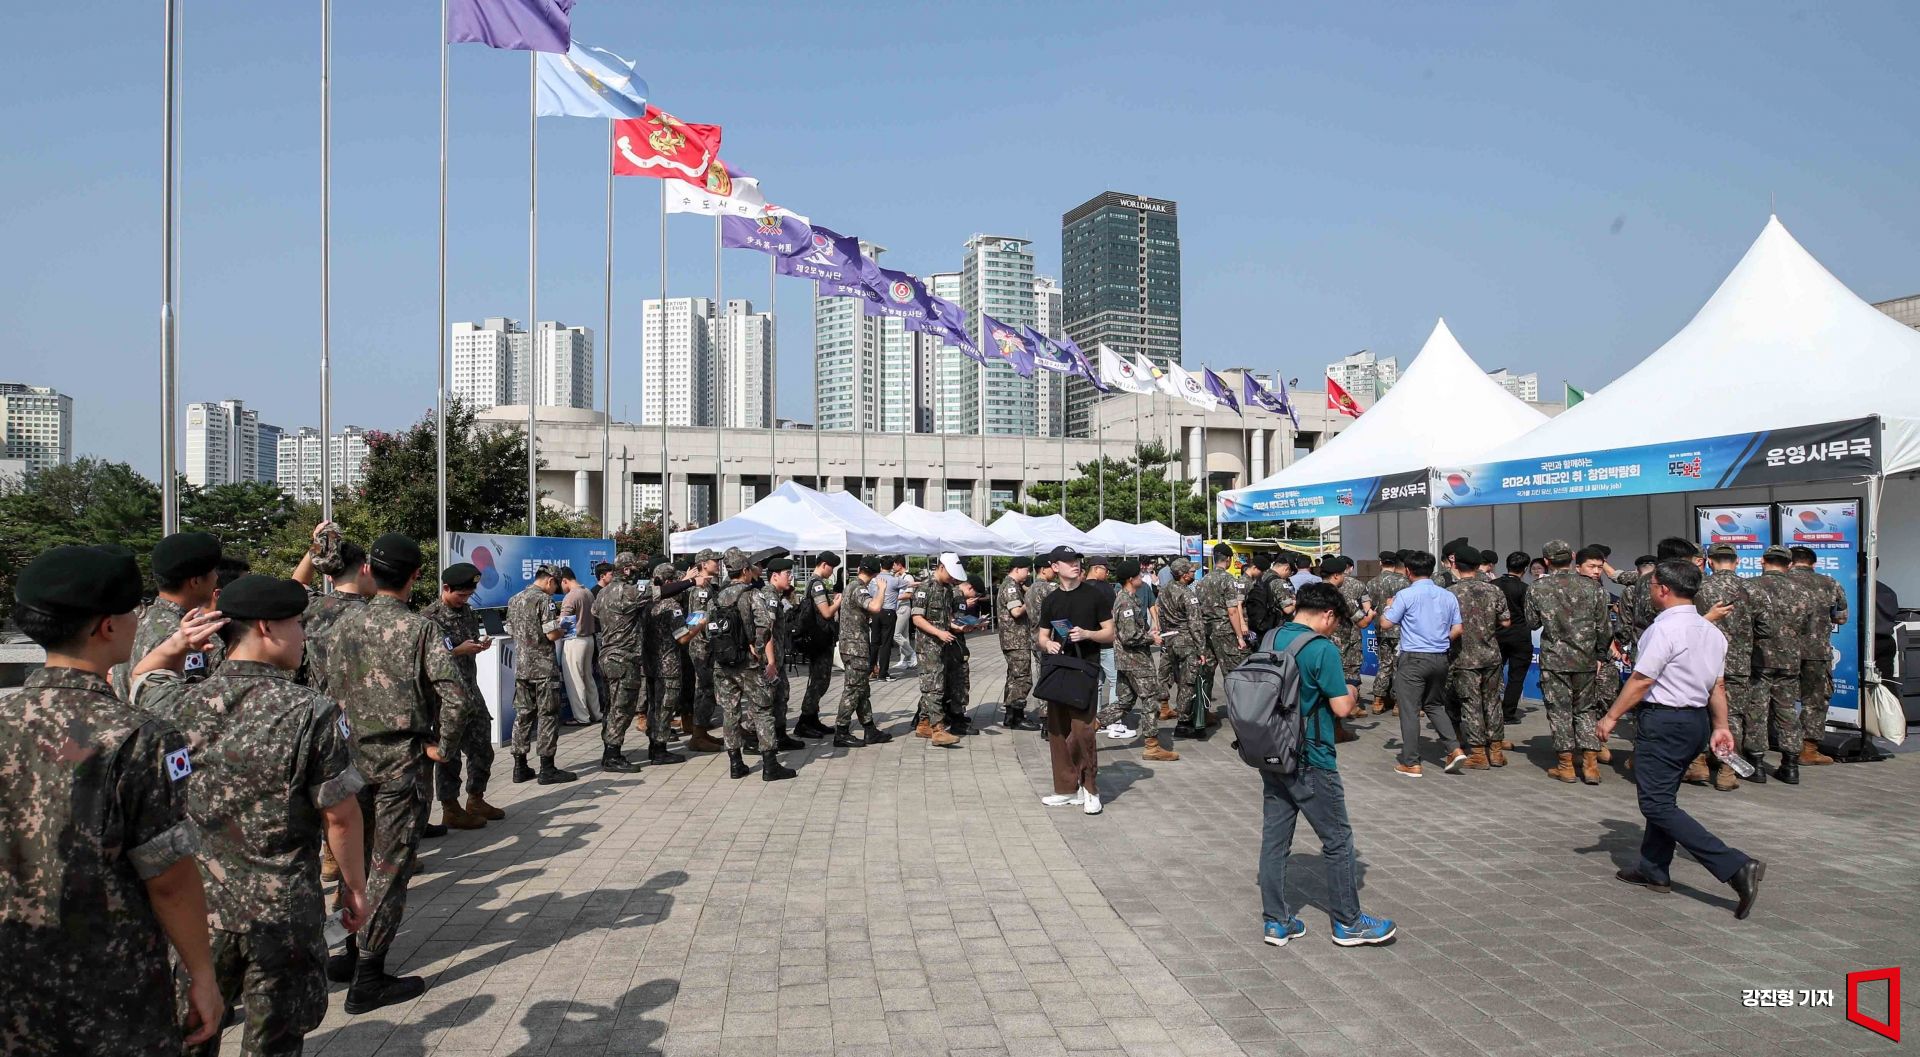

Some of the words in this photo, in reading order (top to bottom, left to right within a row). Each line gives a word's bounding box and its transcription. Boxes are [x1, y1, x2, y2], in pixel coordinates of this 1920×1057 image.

[1120, 199, 1166, 213] WORLDMARK
[1766, 437, 1872, 467] 운영사무국
[1541, 462, 1562, 471] 국민과
[1563, 457, 1593, 469] 함께하는
[1502, 476, 1531, 488] 2024
[1532, 471, 1570, 486] 제대군인
[1381, 482, 1426, 500] 운영사무국
